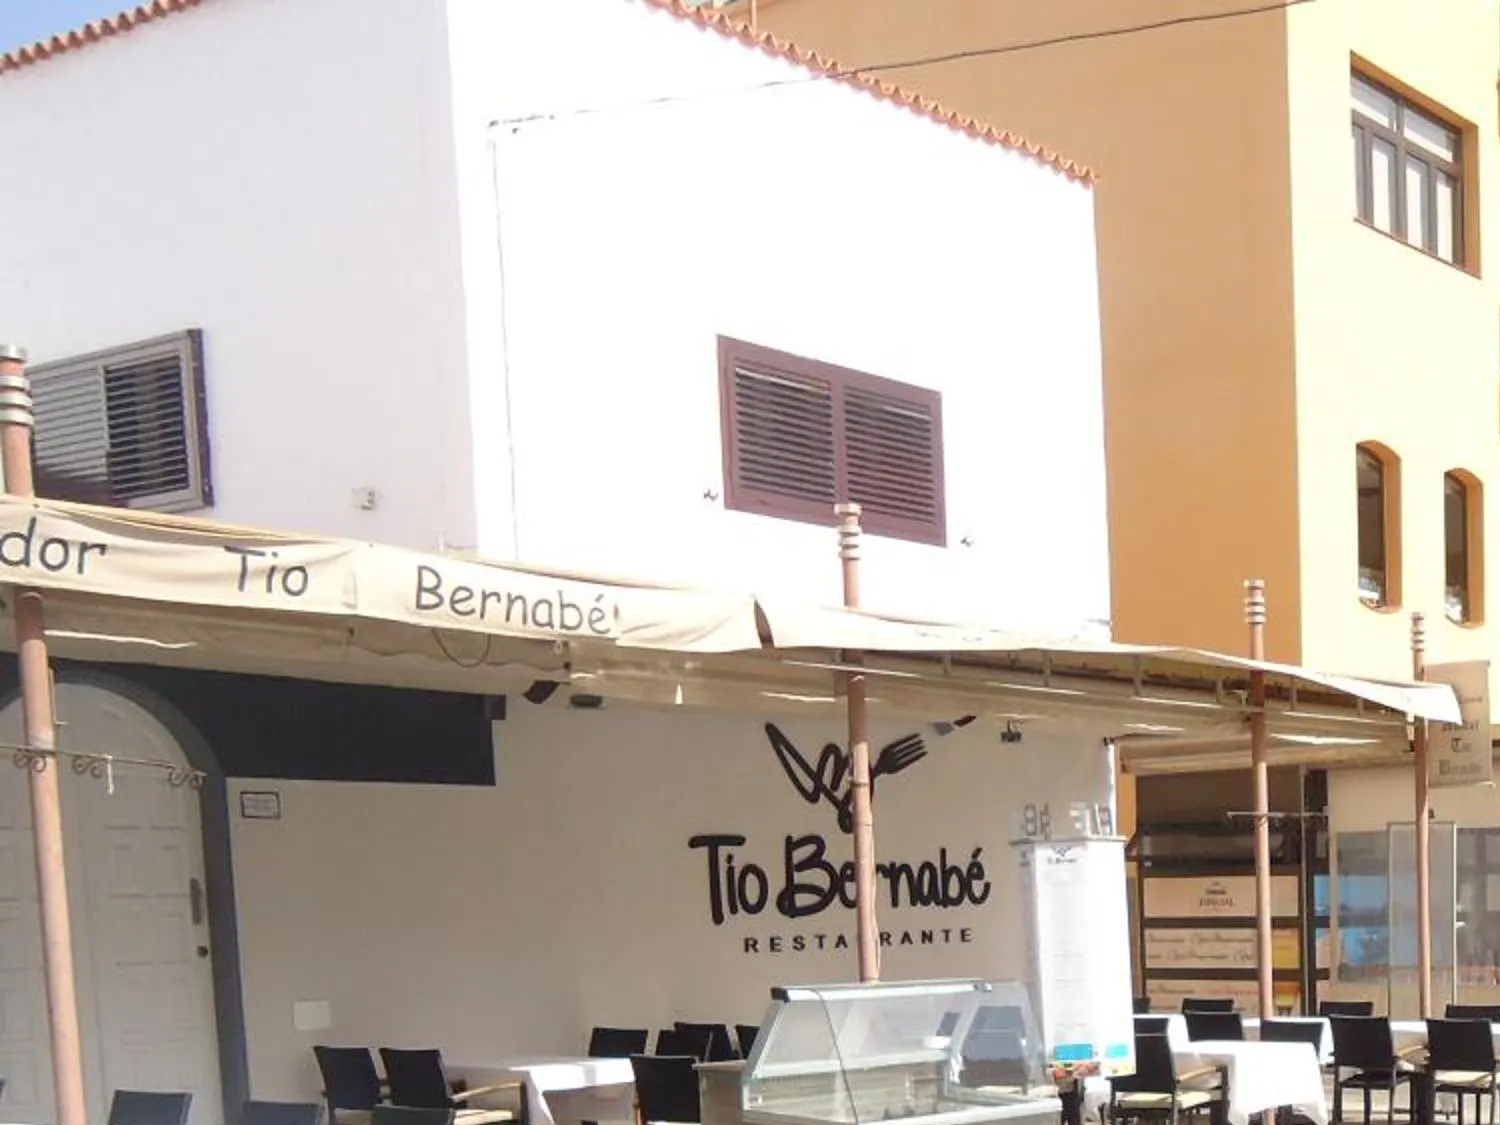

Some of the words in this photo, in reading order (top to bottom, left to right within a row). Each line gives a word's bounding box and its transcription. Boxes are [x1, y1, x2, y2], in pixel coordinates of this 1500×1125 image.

[223, 545, 309, 597] Tio
[415, 564, 612, 635] Bernabé
[687, 834, 769, 926] Tio
[743, 927, 974, 953] RESTARANTE
